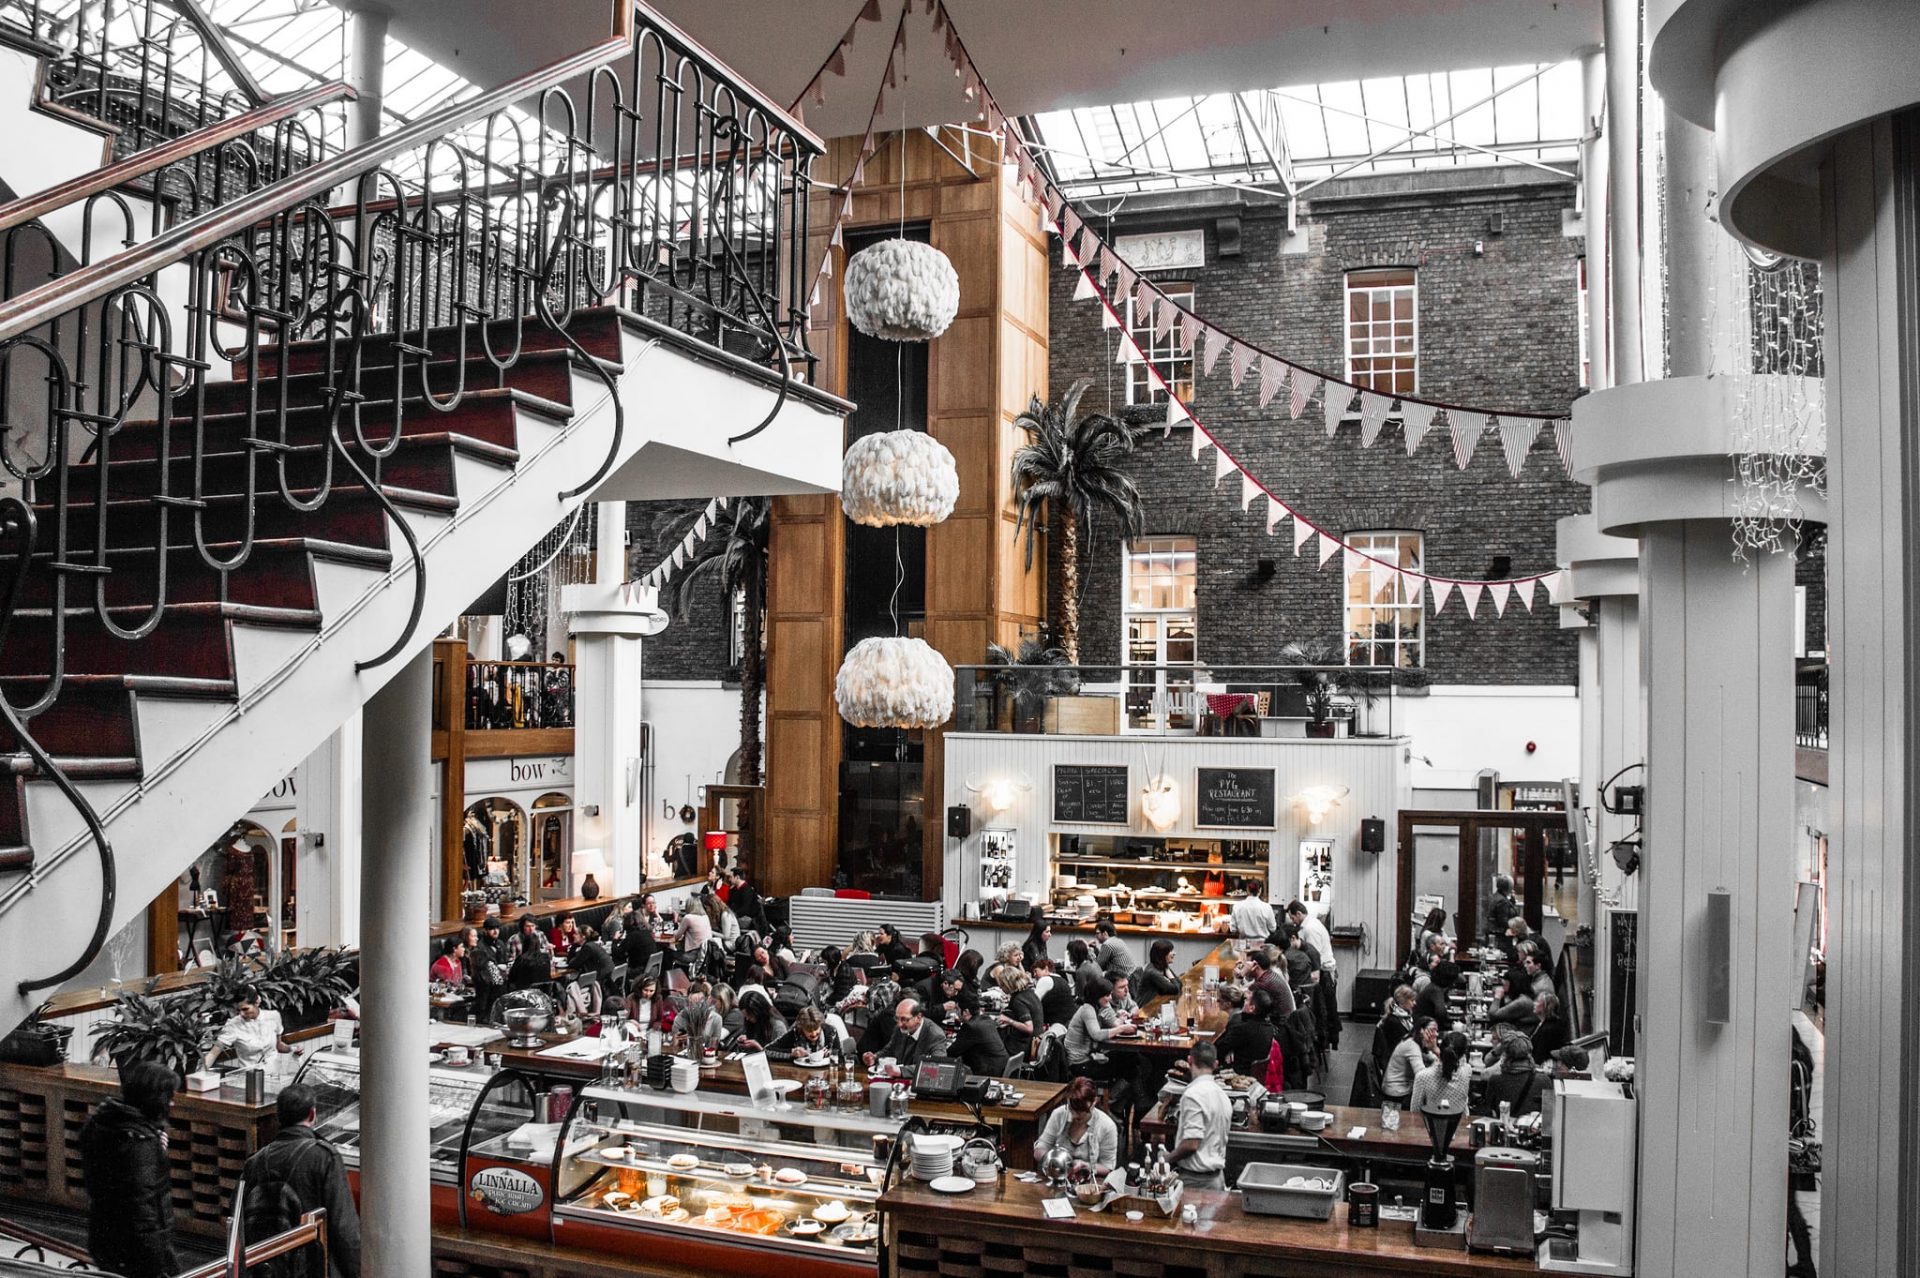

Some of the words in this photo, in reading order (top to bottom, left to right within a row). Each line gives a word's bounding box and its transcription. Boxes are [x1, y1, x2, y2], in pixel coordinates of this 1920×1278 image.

[511, 757, 546, 782] bow
[1219, 779, 1238, 790] PYG
[479, 1173, 538, 1195] LINNALLA
